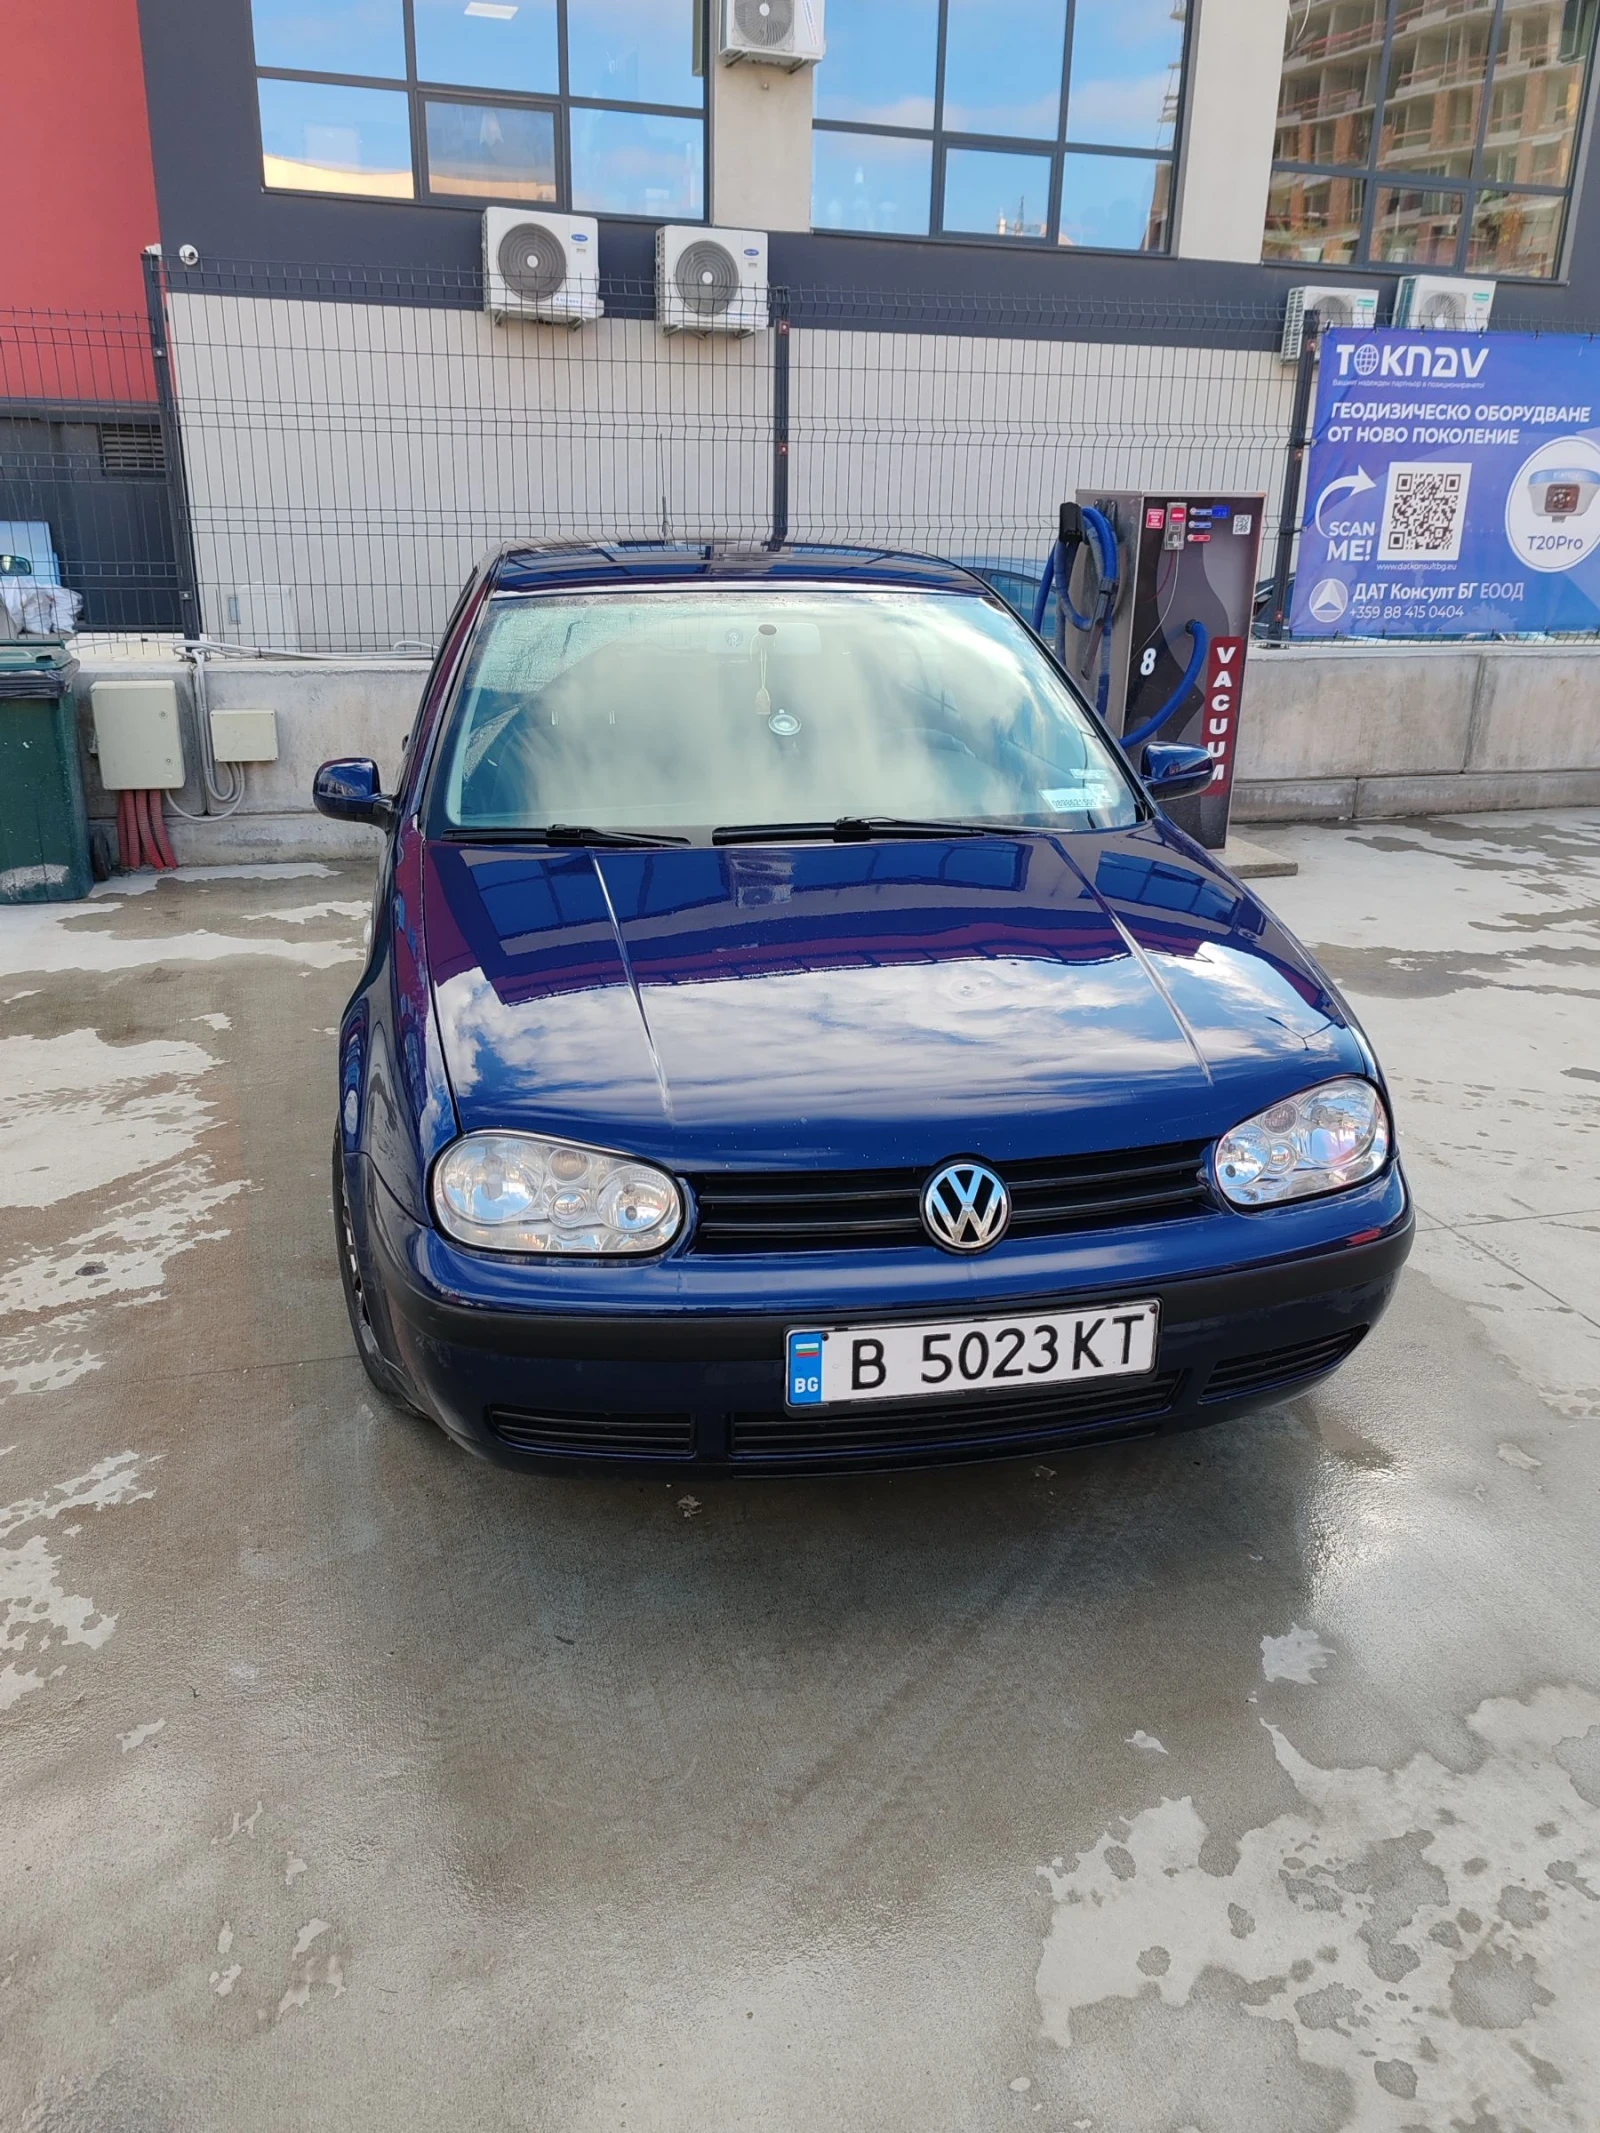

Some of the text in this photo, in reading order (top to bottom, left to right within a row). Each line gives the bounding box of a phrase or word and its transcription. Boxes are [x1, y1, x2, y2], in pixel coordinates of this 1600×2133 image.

[1331, 402, 1592, 424] ГЕОДИЗИЧЕСКО ОБОРУДВАНЕ
[1327, 426, 1520, 444] ОТ НОВО ПОКОЛЕНИЕ
[1329, 521, 1375, 537] SCAN
[1327, 540, 1373, 561] ME!
[1527, 536, 1583, 550] T20Pro
[1352, 582, 1524, 603] ДАТ Консулт БГ ЕООД
[1349, 605, 1464, 619] +359 88 415 0404
[1140, 648, 1157, 676] 8
[850, 1338, 887, 1391] B
[794, 1377, 819, 1393] BG
